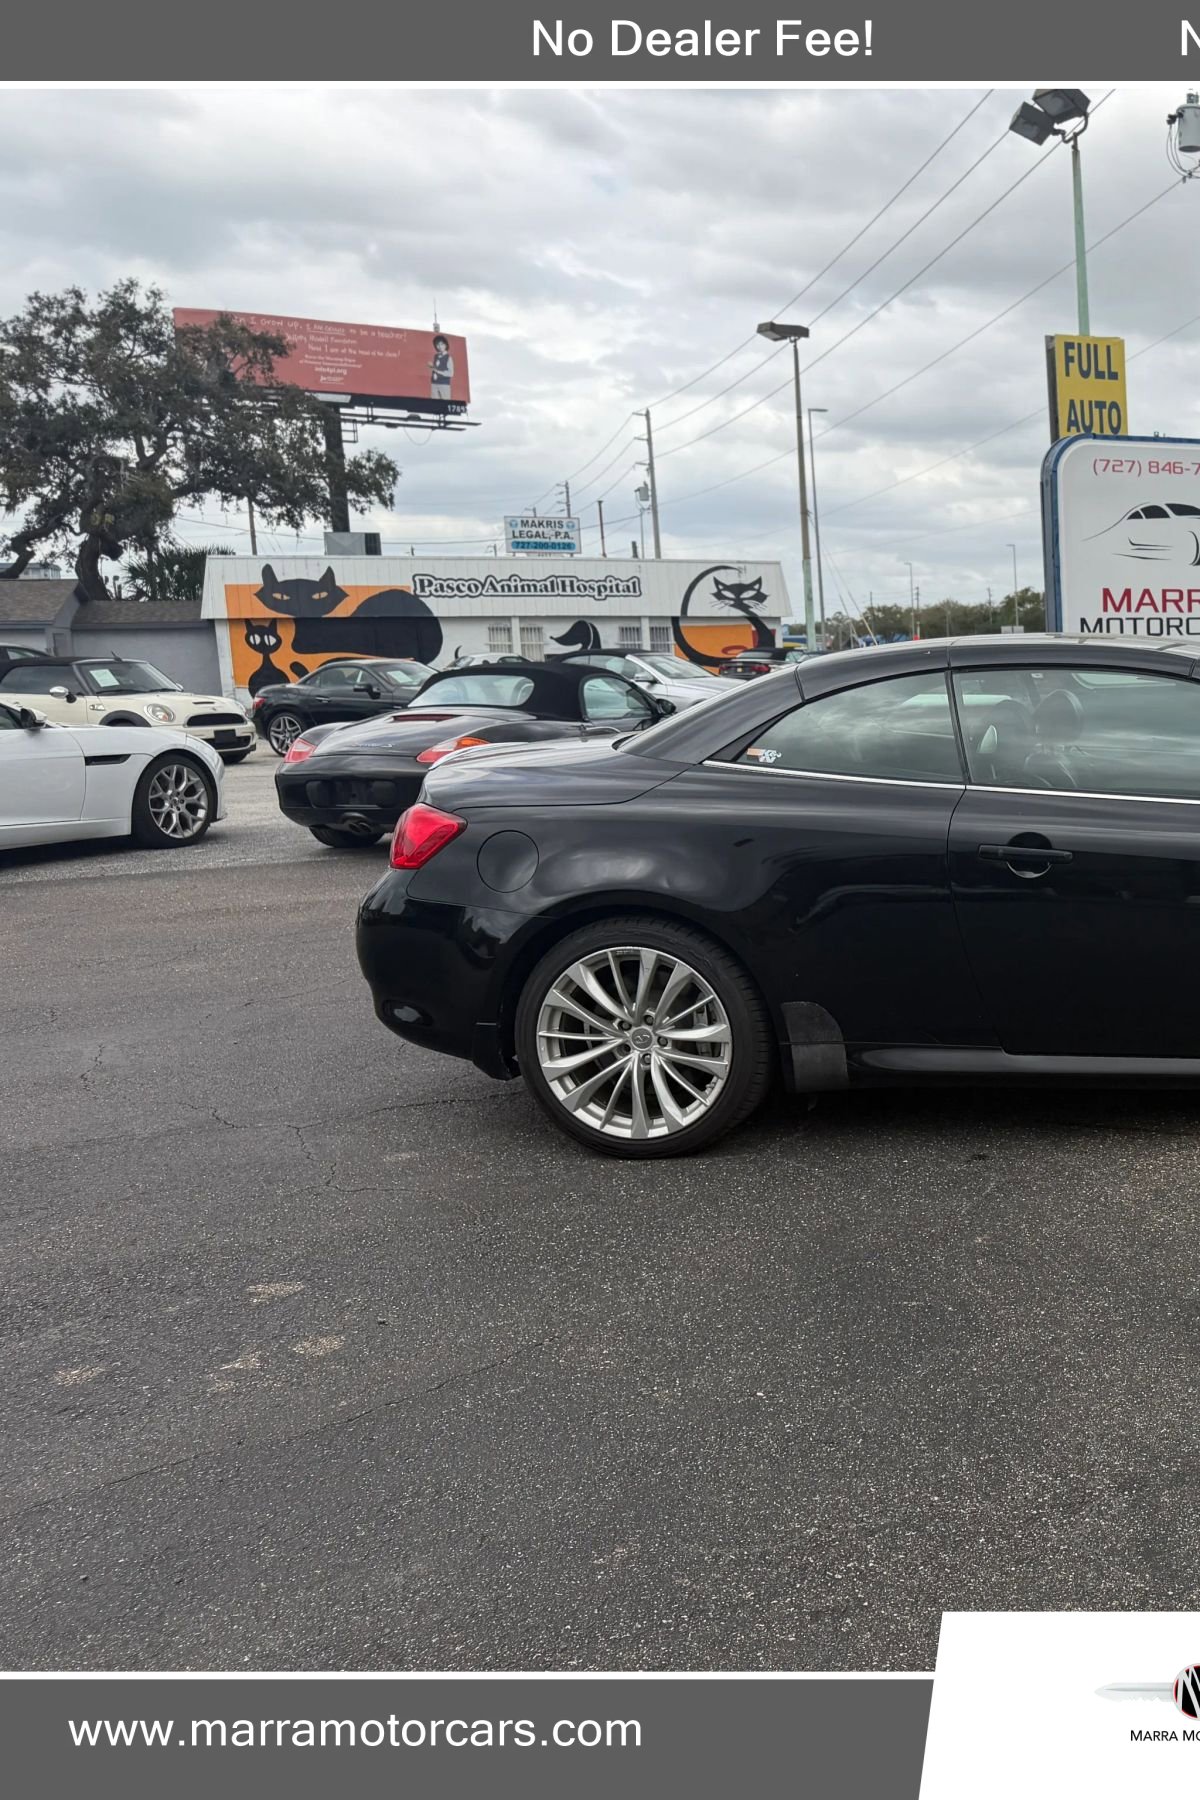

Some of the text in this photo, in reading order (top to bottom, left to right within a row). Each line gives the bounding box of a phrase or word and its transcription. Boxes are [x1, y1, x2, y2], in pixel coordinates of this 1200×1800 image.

[1063, 341, 1119, 380] FULL
[1067, 399, 1122, 434] AUTO
[1093, 458, 1142, 477] (727)
[520, 519, 564, 529] MAKRIS
[554, 531, 574, 540] P.A.
[415, 576, 640, 599] Pasco Animal Hospital
